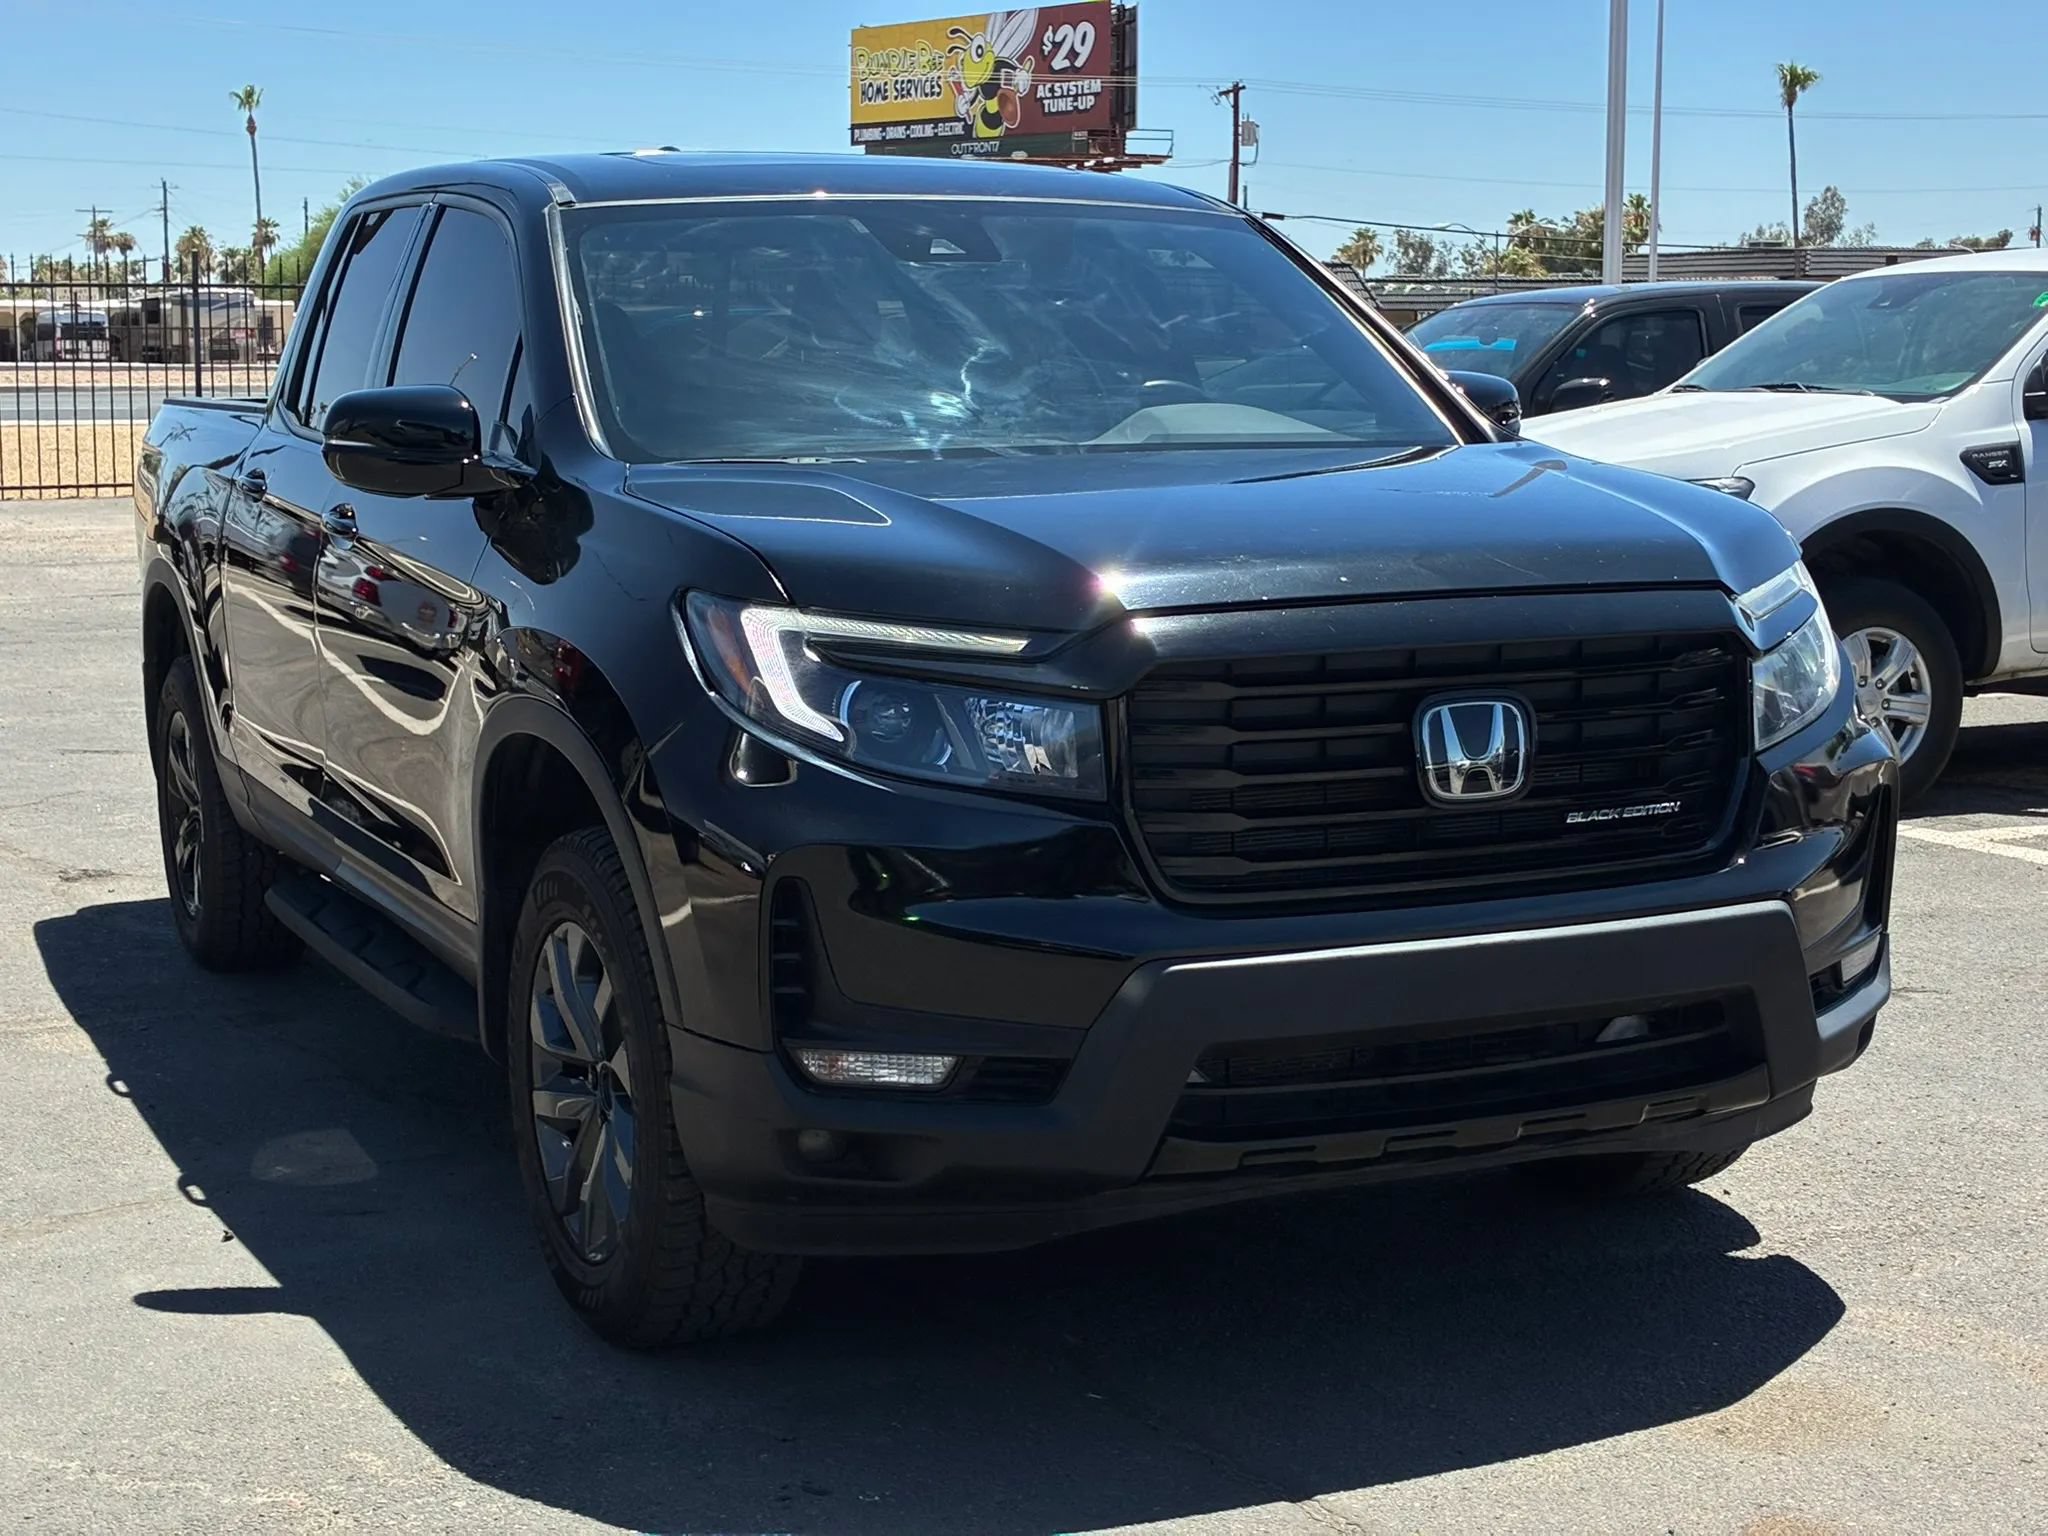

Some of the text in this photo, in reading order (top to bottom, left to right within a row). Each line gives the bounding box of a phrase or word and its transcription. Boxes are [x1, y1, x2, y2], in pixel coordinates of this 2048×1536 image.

[1042, 21, 1095, 70] $29
[855, 40, 944, 81] BUMBLE BEE
[860, 75, 943, 105] HOME SERVICES
[1036, 79, 1102, 99] AC SYSTEM
[1042, 95, 1095, 113] TUNE-UP
[1972, 450, 2009, 458] RANGER
[1566, 801, 1681, 824] BLACK EDITION
